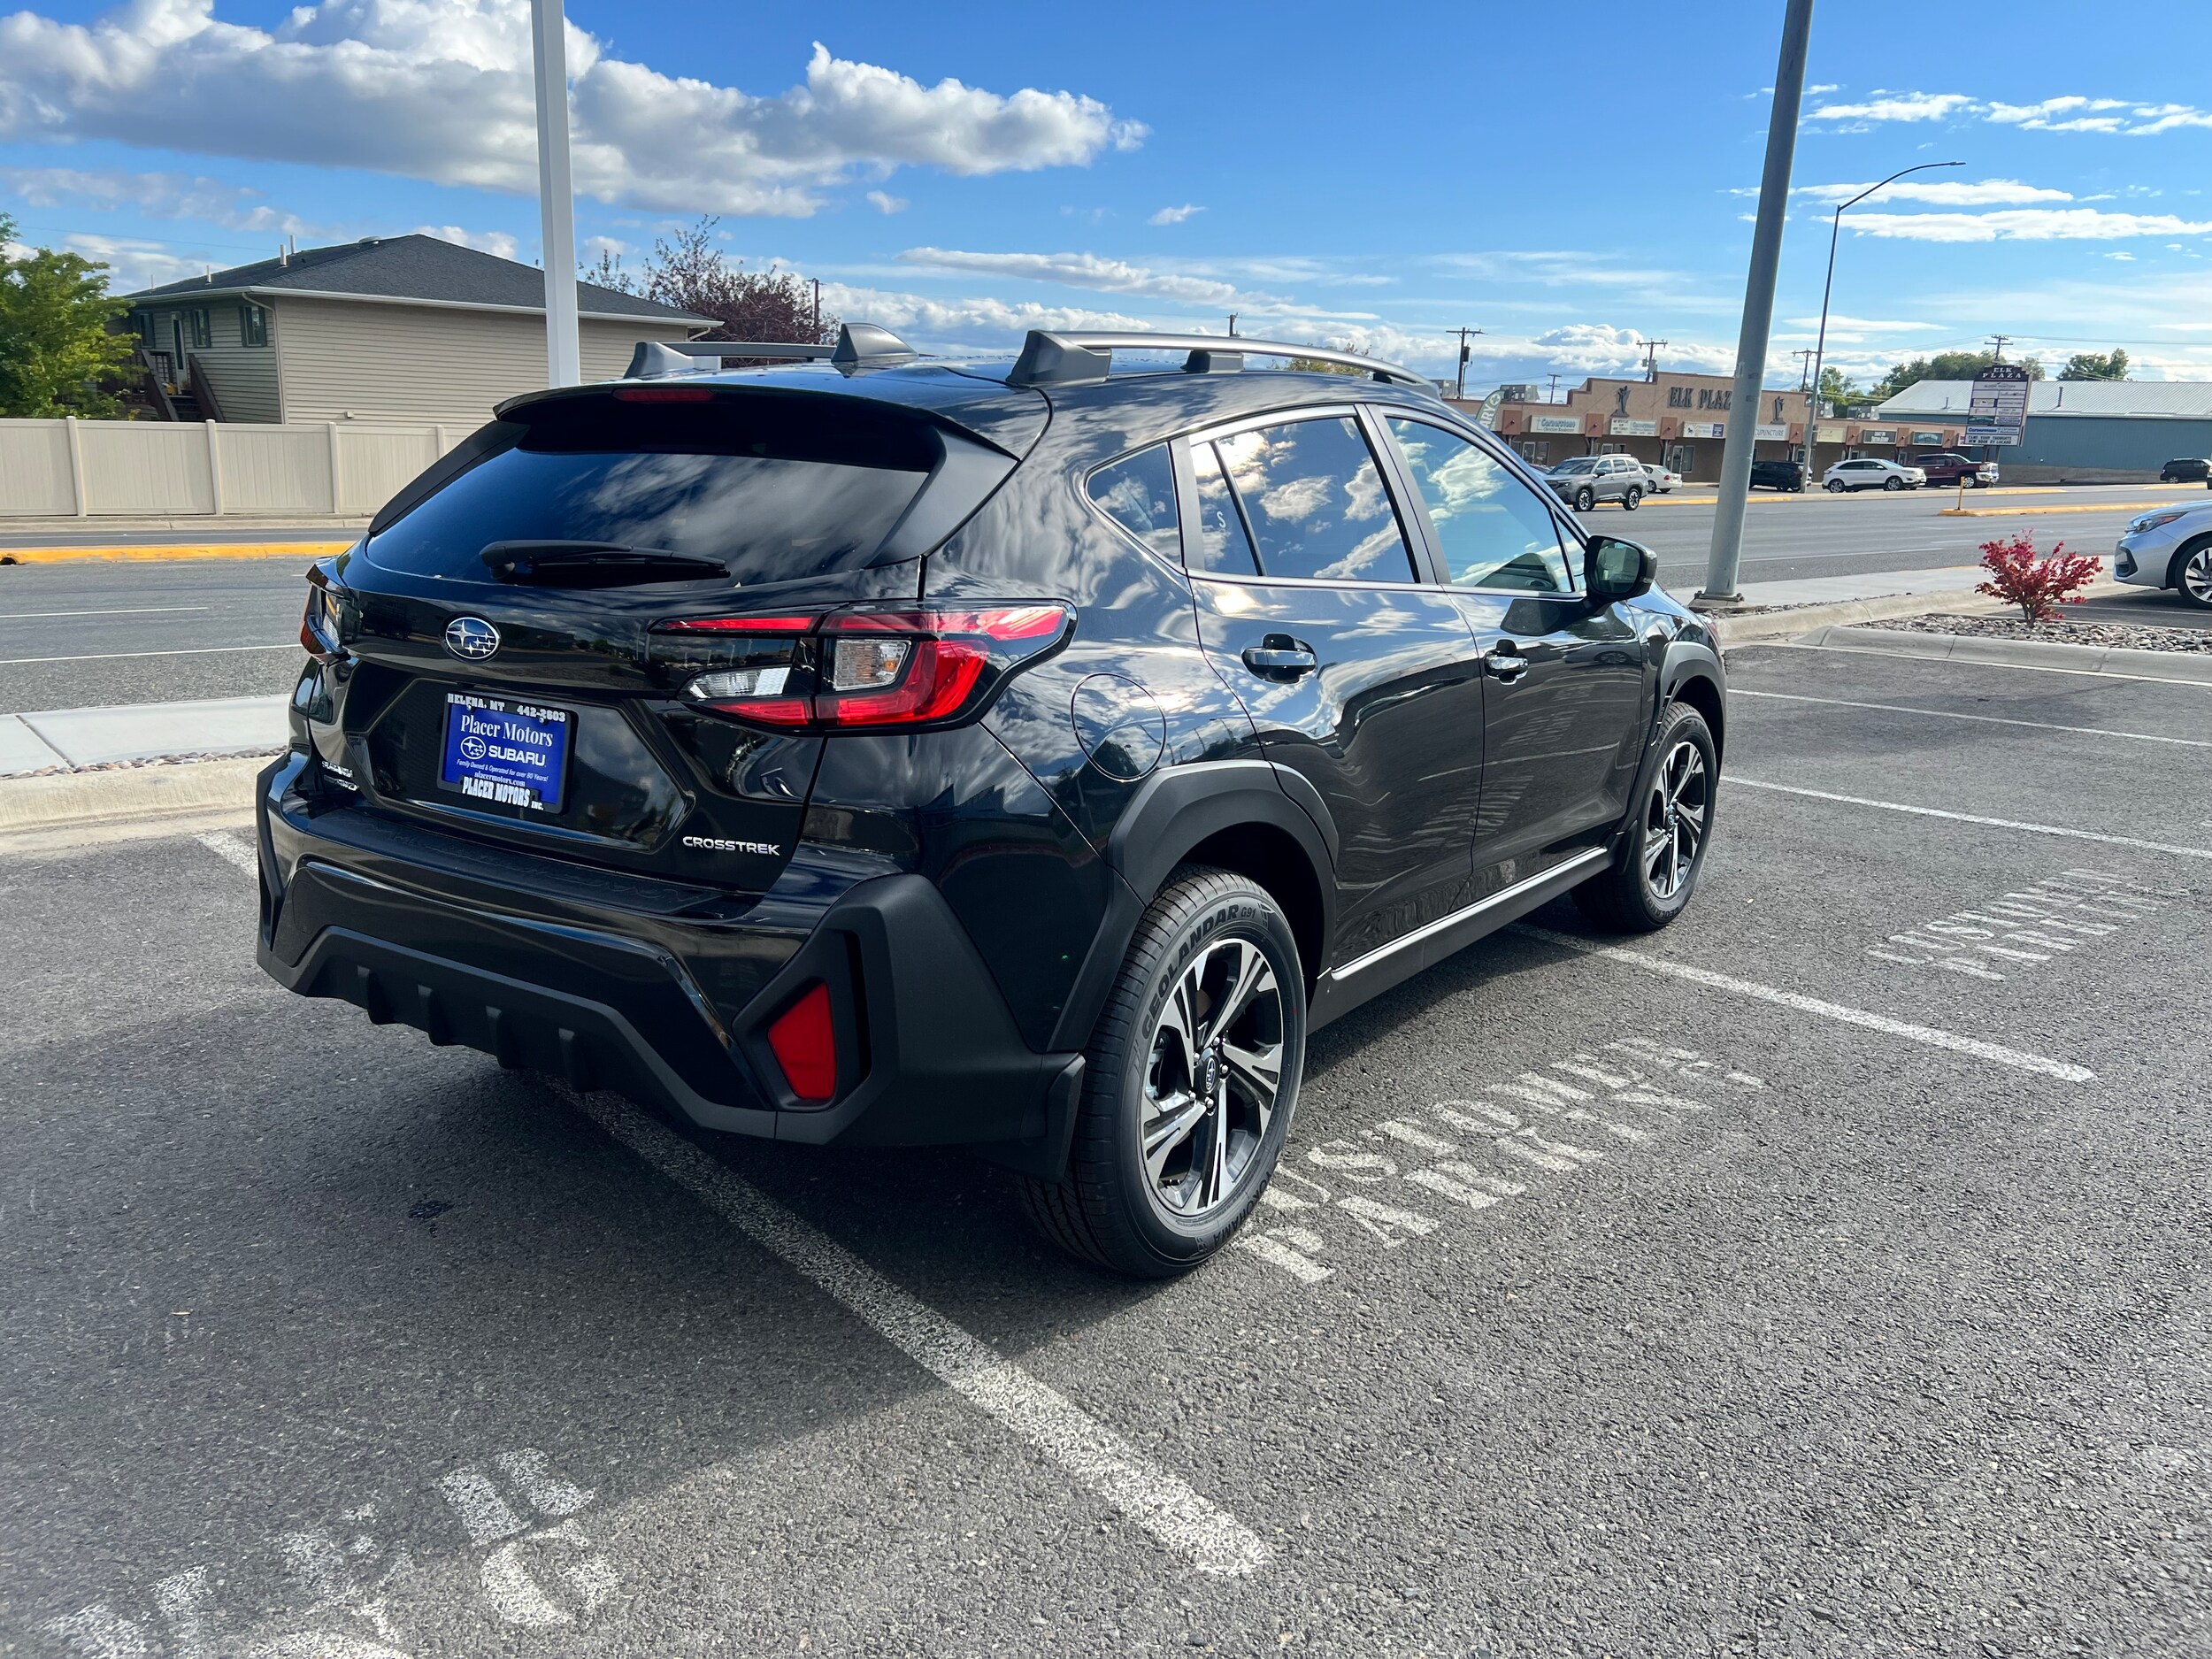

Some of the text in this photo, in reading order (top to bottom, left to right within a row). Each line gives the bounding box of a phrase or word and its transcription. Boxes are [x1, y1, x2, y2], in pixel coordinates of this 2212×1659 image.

[1669, 387, 1732, 411] ELK PLAZ
[447, 693, 487, 709] HELENA,
[489, 700, 505, 711] MT
[460, 714, 553, 747] Placer Motors
[457, 758, 471, 768] Family
[470, 761, 485, 771] Owned
[488, 765, 509, 775] Operated
[488, 745, 546, 766] SUBARU
[462, 776, 495, 800] PLACER
[495, 783, 531, 807] MOTORS
[682, 836, 780, 856] CROSSTREK
[1141, 903, 1256, 1040] GEOLANDAR G91
[1214, 1171, 1272, 1247] YOKOHAMA
